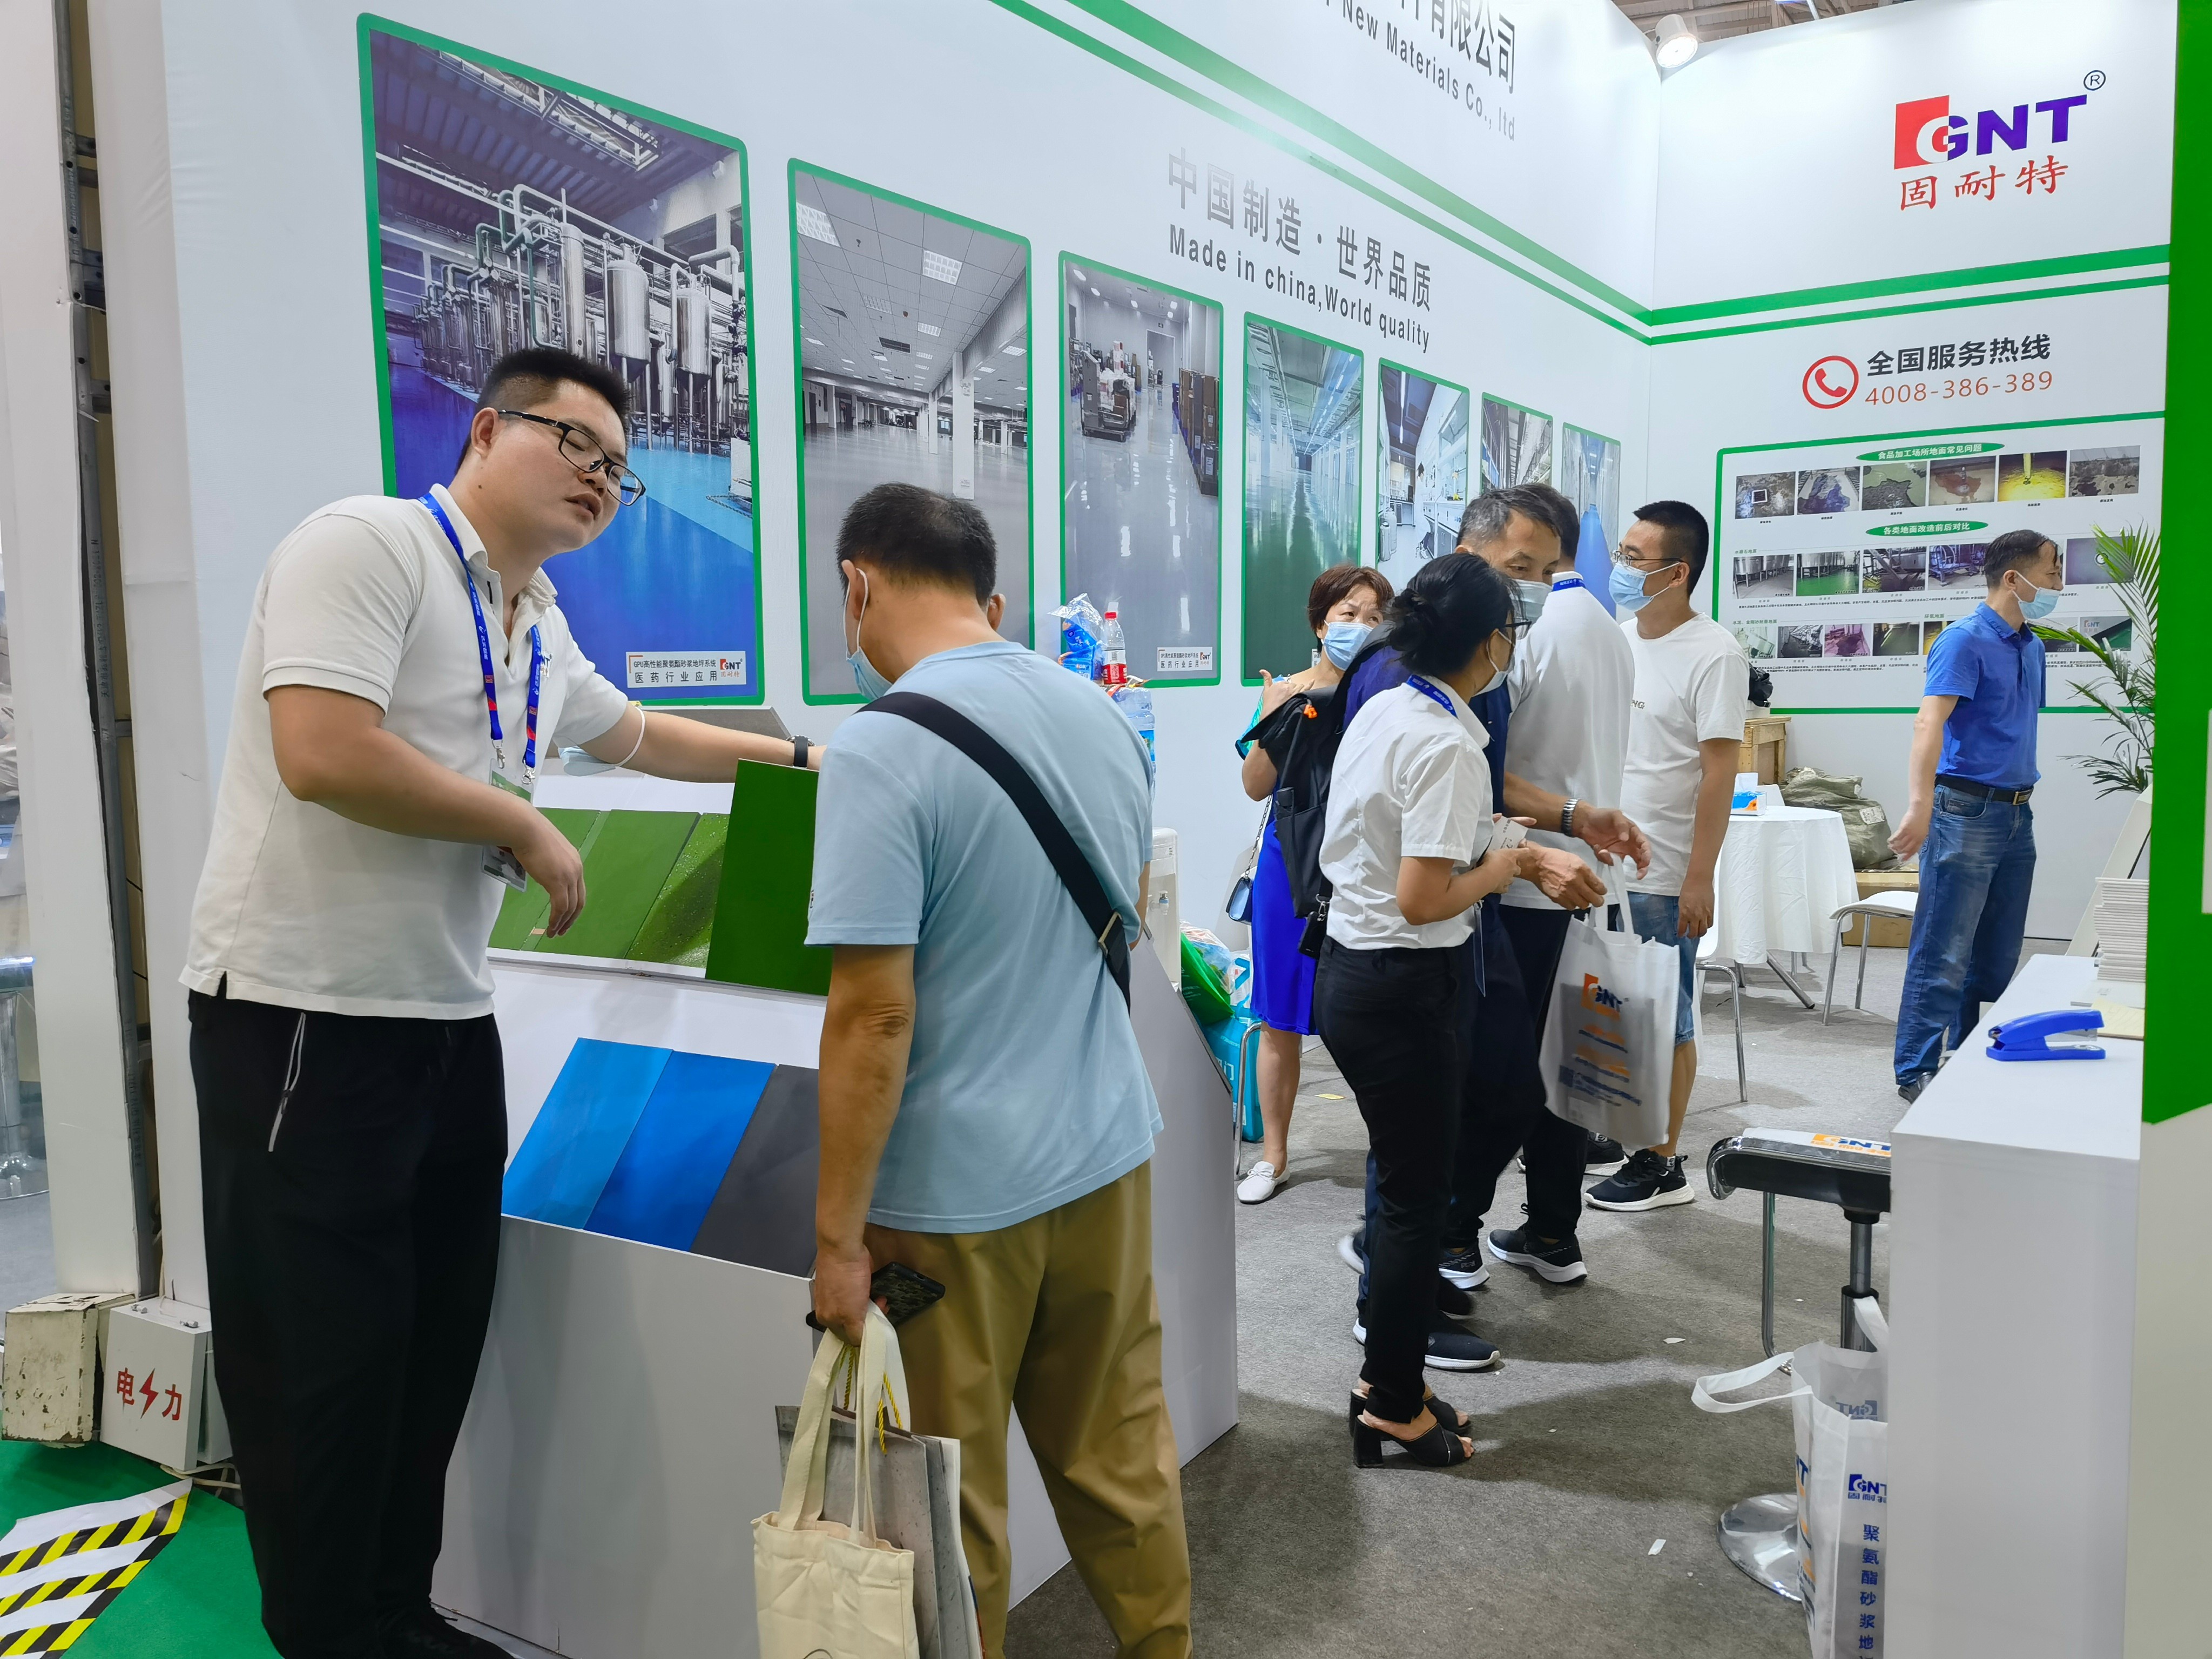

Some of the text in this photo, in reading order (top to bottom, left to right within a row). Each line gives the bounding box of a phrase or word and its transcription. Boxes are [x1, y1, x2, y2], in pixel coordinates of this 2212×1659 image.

[1387, 21, 1459, 100] Materials
[1401, 0, 1515, 94] 有限公司
[1912, 94, 2088, 165] GNT
[1900, 154, 2069, 211] 固耐特
[1170, 223, 1227, 272] Made
[1237, 250, 1255, 282] in
[1379, 313, 1429, 354] quality
[1866, 333, 2051, 376] 全国服务热线
[1865, 370, 2053, 406] 4008-386-389
[1877, 443, 1982, 460] 食品加工场所地面常见问题
[1883, 522, 1971, 535] 各类地面改造前后对比
[635, 671, 717, 683] 医药行业应用
[1858, 1523, 1880, 1659] 聚氨酯砂浆地
